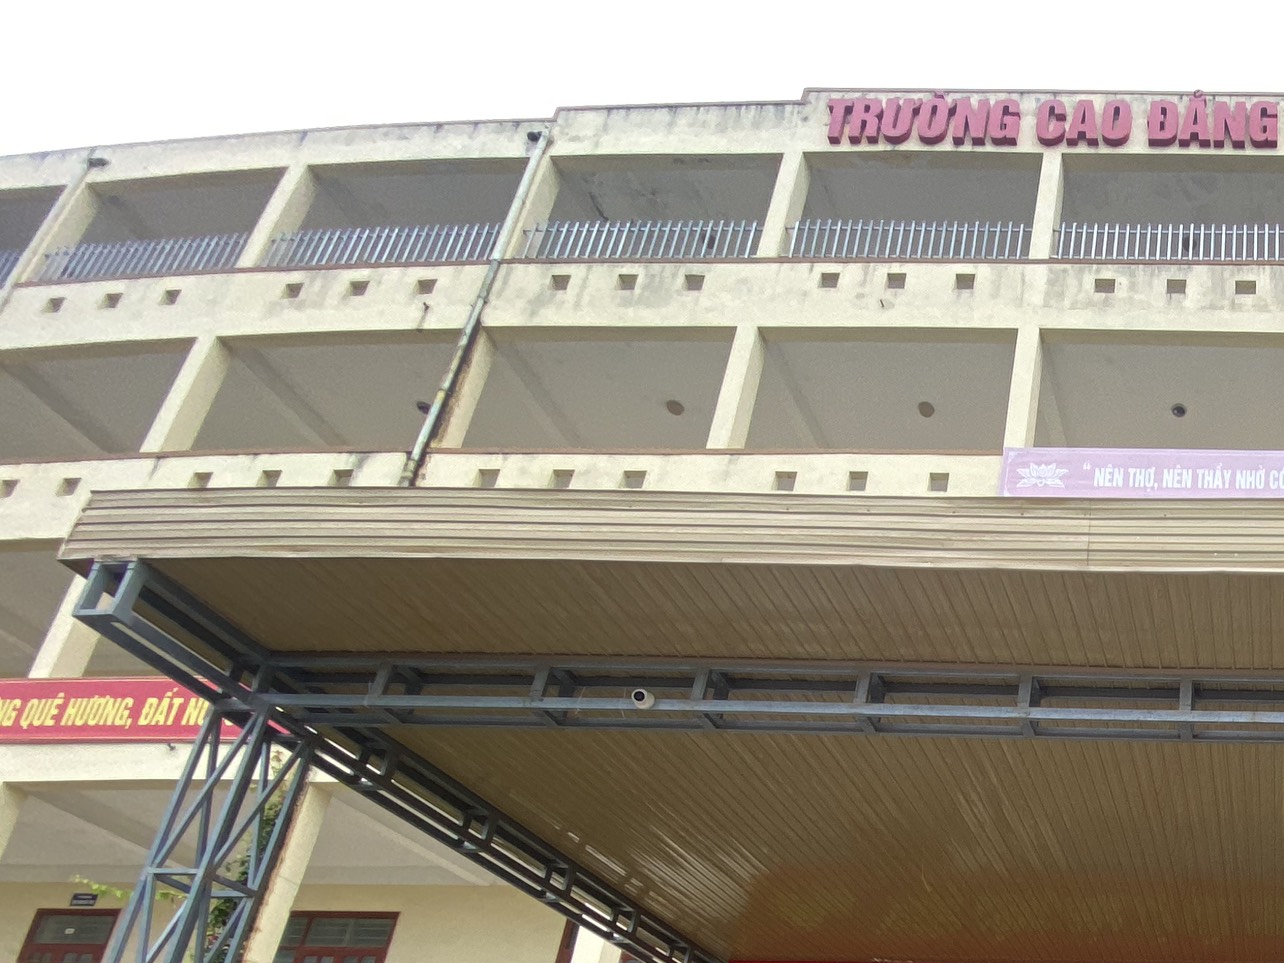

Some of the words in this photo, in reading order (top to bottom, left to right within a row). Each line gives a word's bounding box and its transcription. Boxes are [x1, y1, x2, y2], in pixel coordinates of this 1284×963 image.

[827, 90, 1020, 146] TRƯỜNG
[1036, 98, 1133, 147] CAO
[1162, 464, 1193, 489] NÊN
[20, 692, 65, 730] QUÊ
[138, 687, 185, 727] ĐẤT
